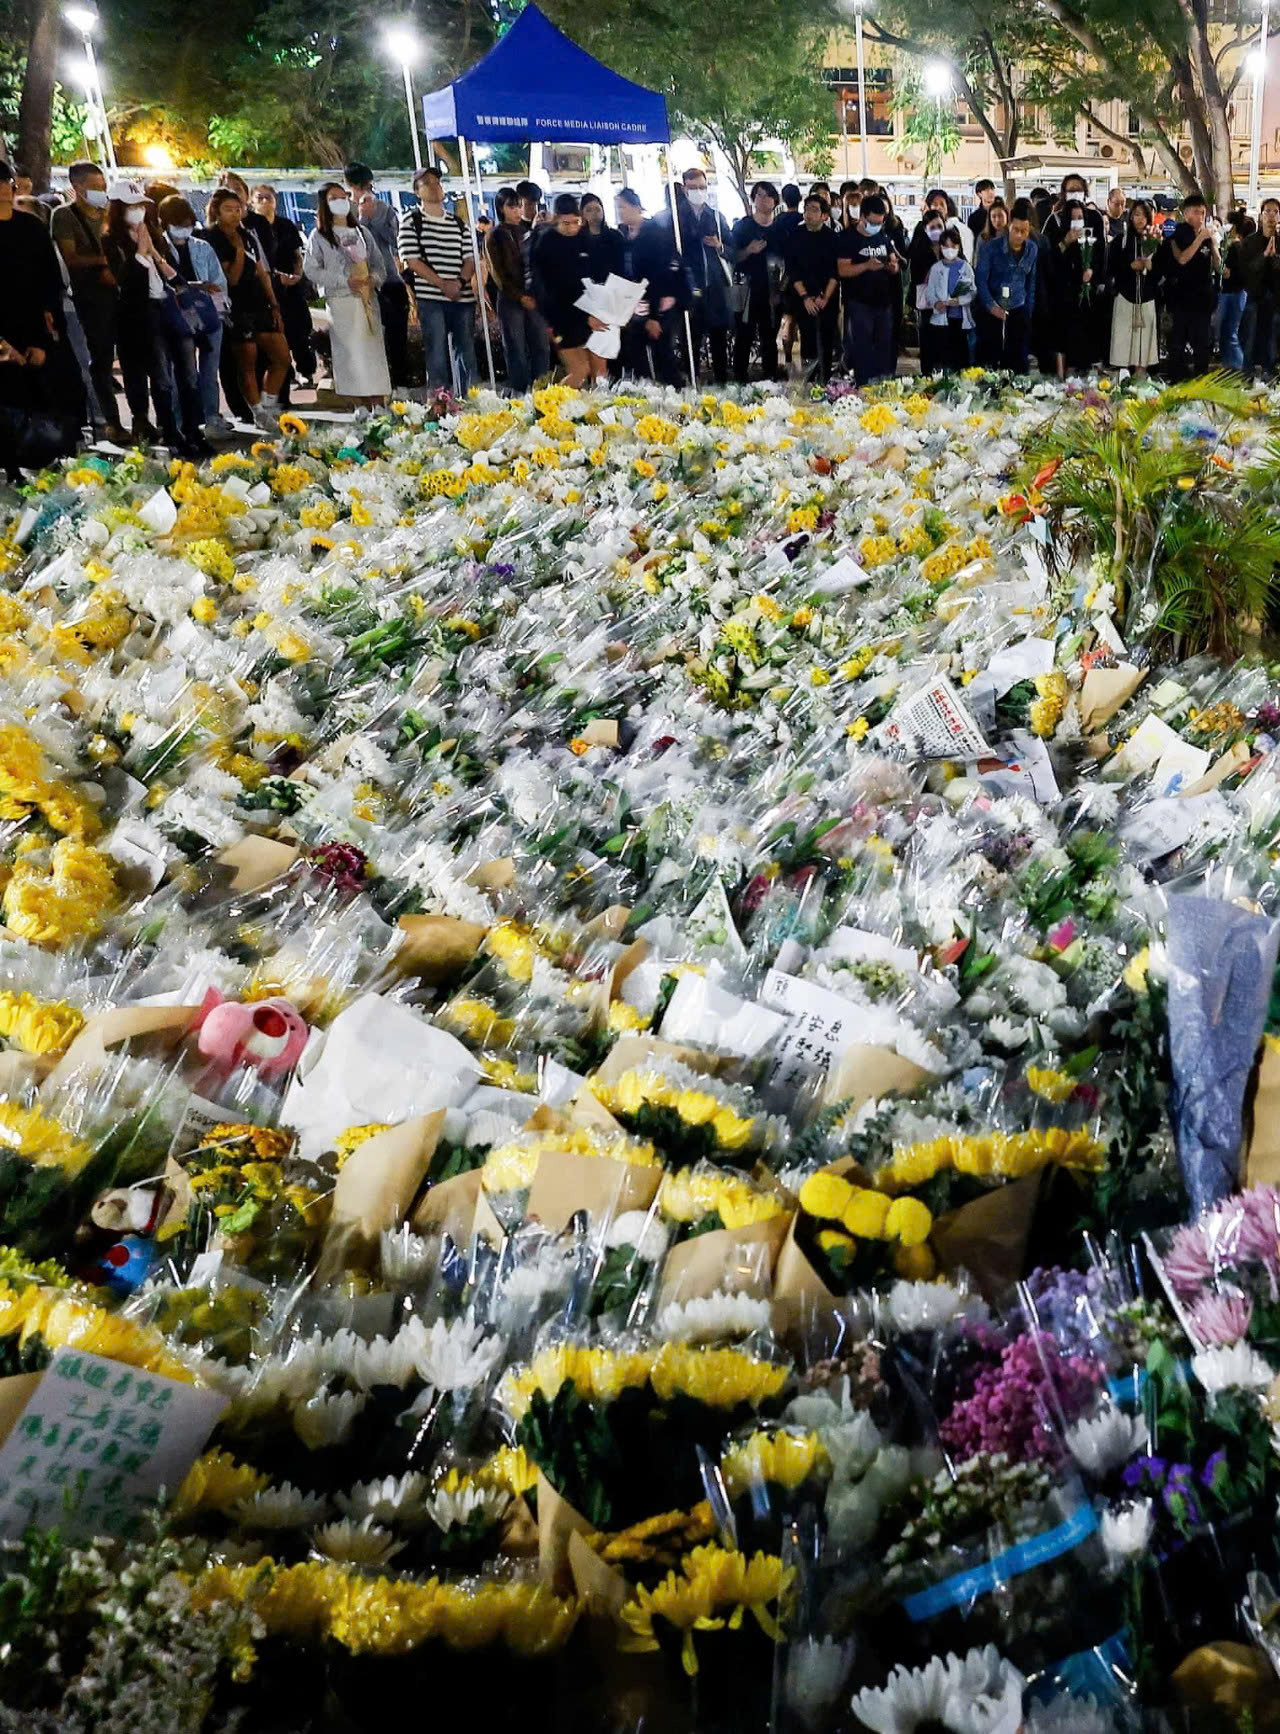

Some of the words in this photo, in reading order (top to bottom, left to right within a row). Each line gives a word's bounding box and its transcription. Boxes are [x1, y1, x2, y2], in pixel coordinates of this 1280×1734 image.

[535, 118, 563, 128] FORCE
[564, 120, 589, 129] MEDIA
[590, 121, 620, 131] LIAISON
[621, 123, 647, 132] CADRE
